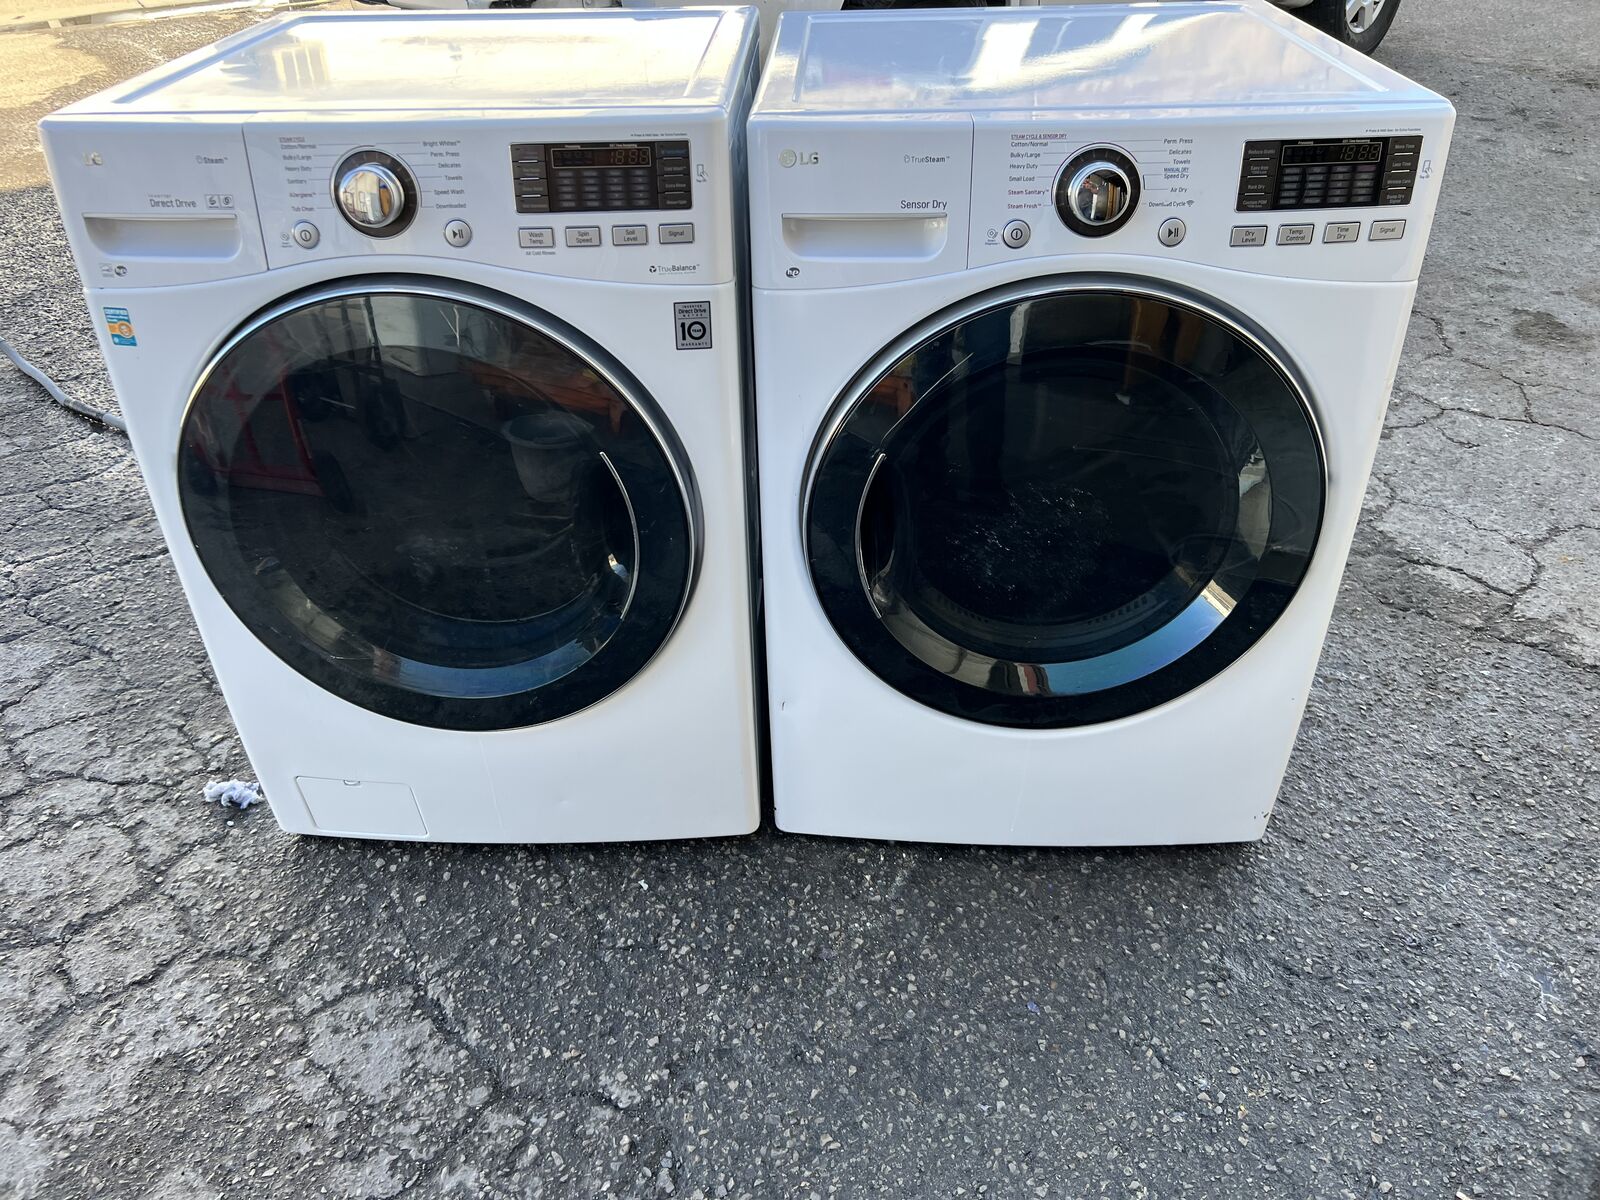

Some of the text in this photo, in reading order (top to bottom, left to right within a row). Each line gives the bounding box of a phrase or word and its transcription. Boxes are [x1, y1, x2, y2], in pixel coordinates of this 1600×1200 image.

[800, 152, 820, 165] LG
[150, 199, 198, 208] Direct Drive
[900, 200, 947, 210] Sensor Dry
[680, 321, 706, 340] 10
